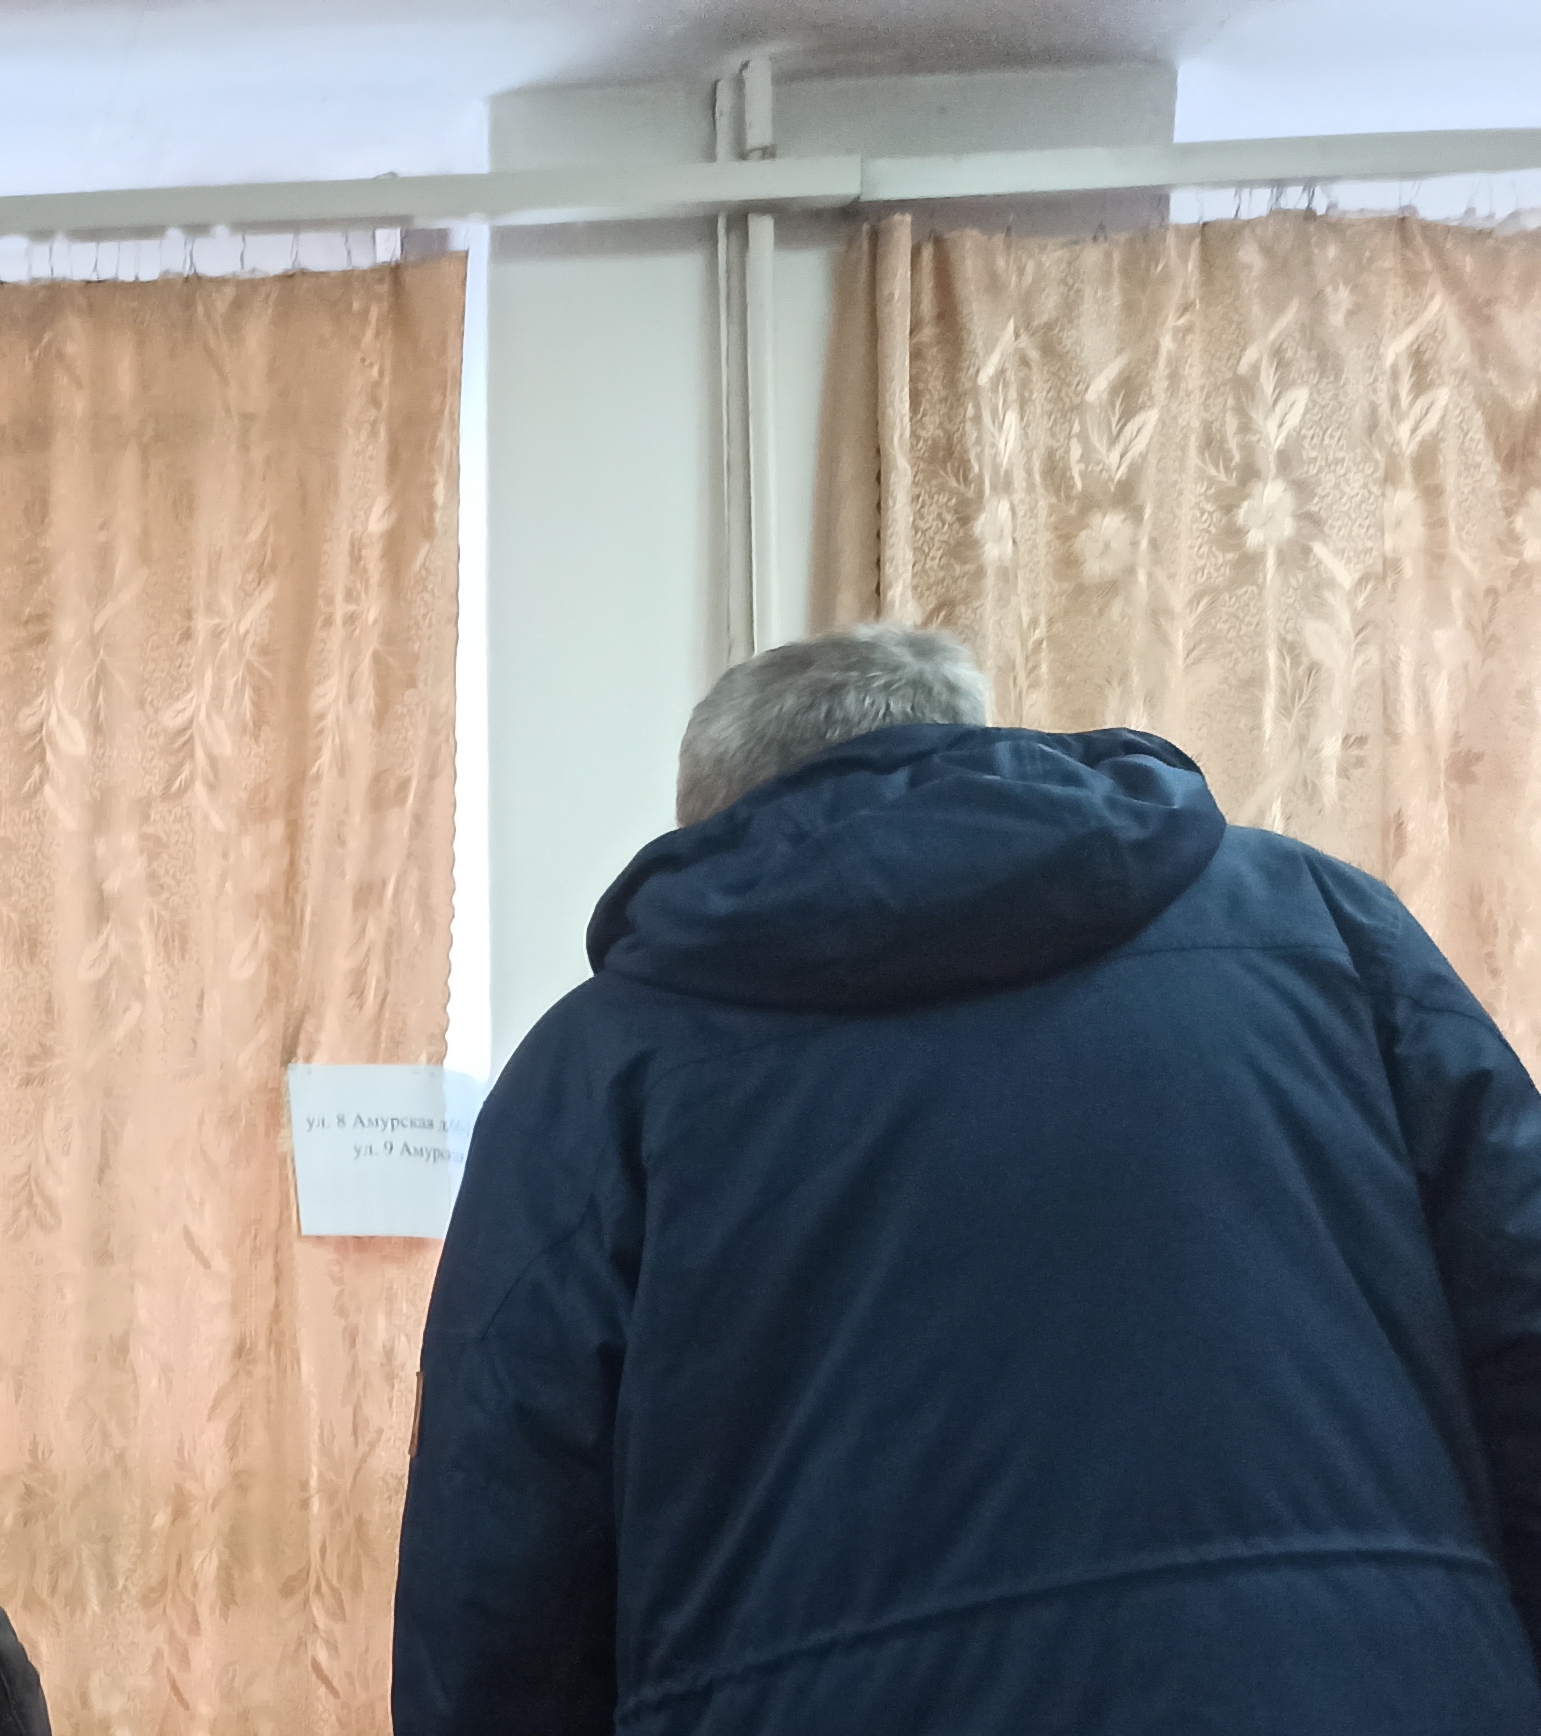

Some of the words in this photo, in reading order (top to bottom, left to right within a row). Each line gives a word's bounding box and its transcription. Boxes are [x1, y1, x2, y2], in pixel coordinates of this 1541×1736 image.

[305, 1113, 332, 1132] ул.
[336, 1112, 347, 1129] 8
[352, 1112, 435, 1134] Амурская
[353, 1143, 379, 1161] ул.
[383, 1140, 394, 1156] 9
